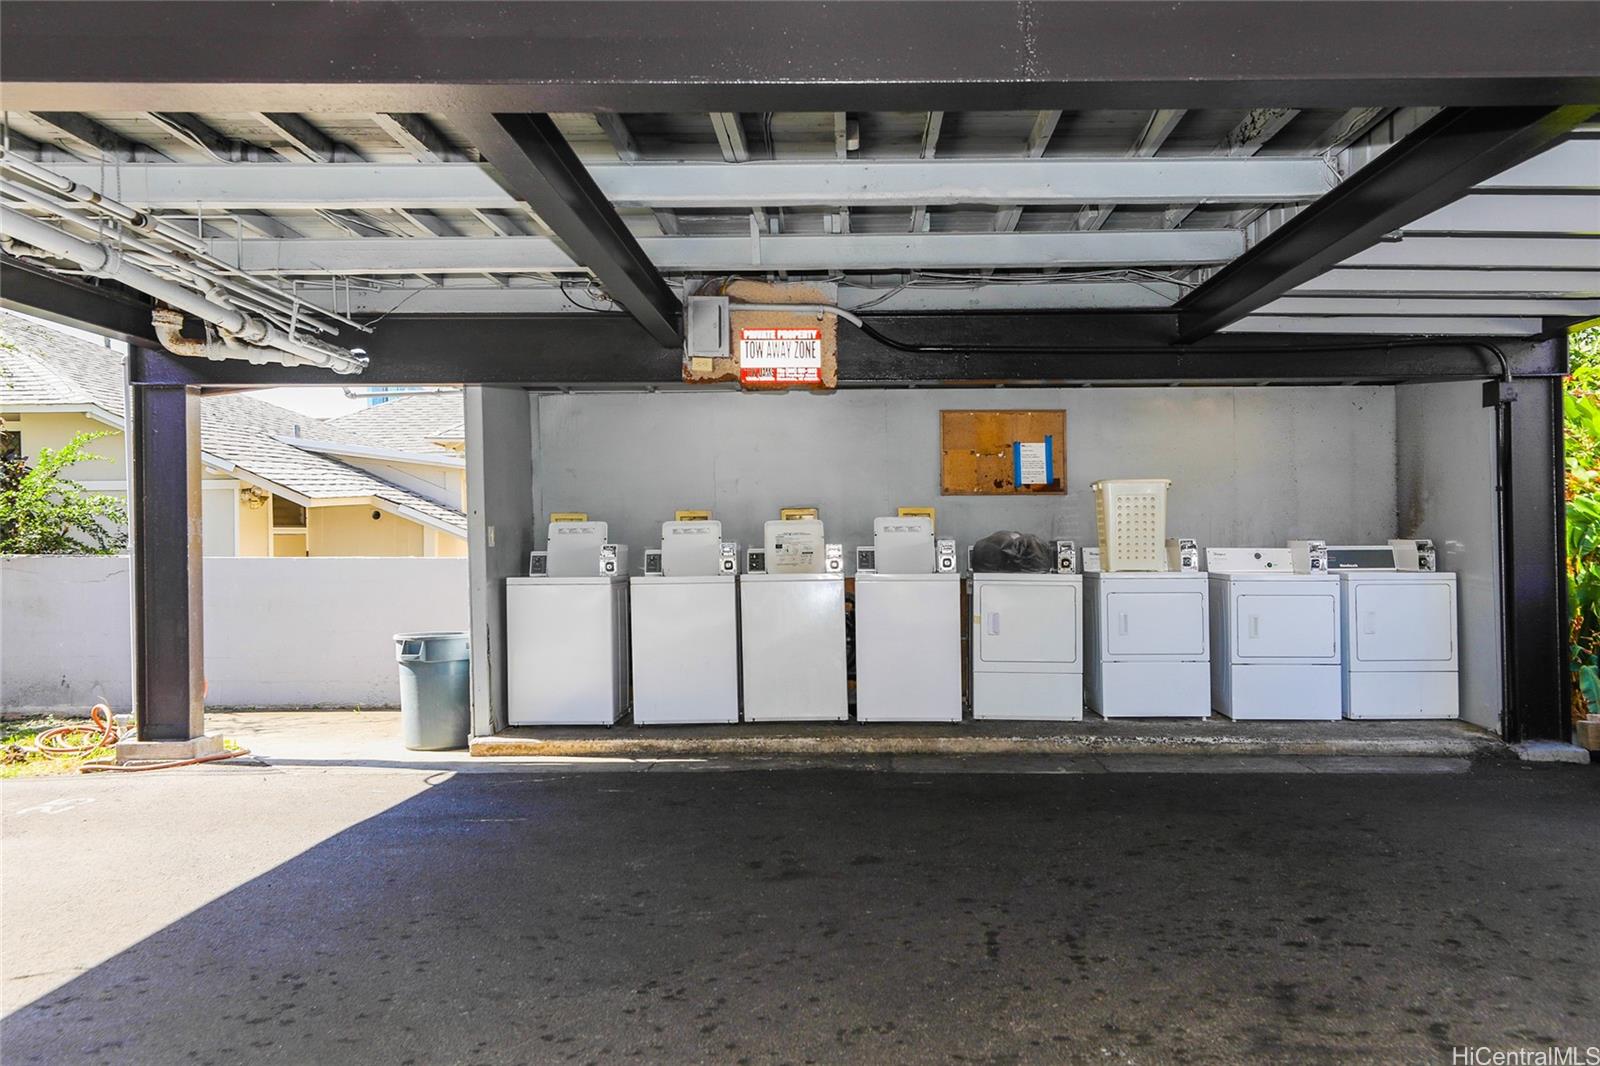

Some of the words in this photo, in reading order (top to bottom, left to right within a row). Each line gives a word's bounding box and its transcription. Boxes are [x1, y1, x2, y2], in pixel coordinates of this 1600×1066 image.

[745, 341, 764, 359] TOW
[766, 341, 792, 359] AWAY
[794, 341, 816, 359] ZONE
